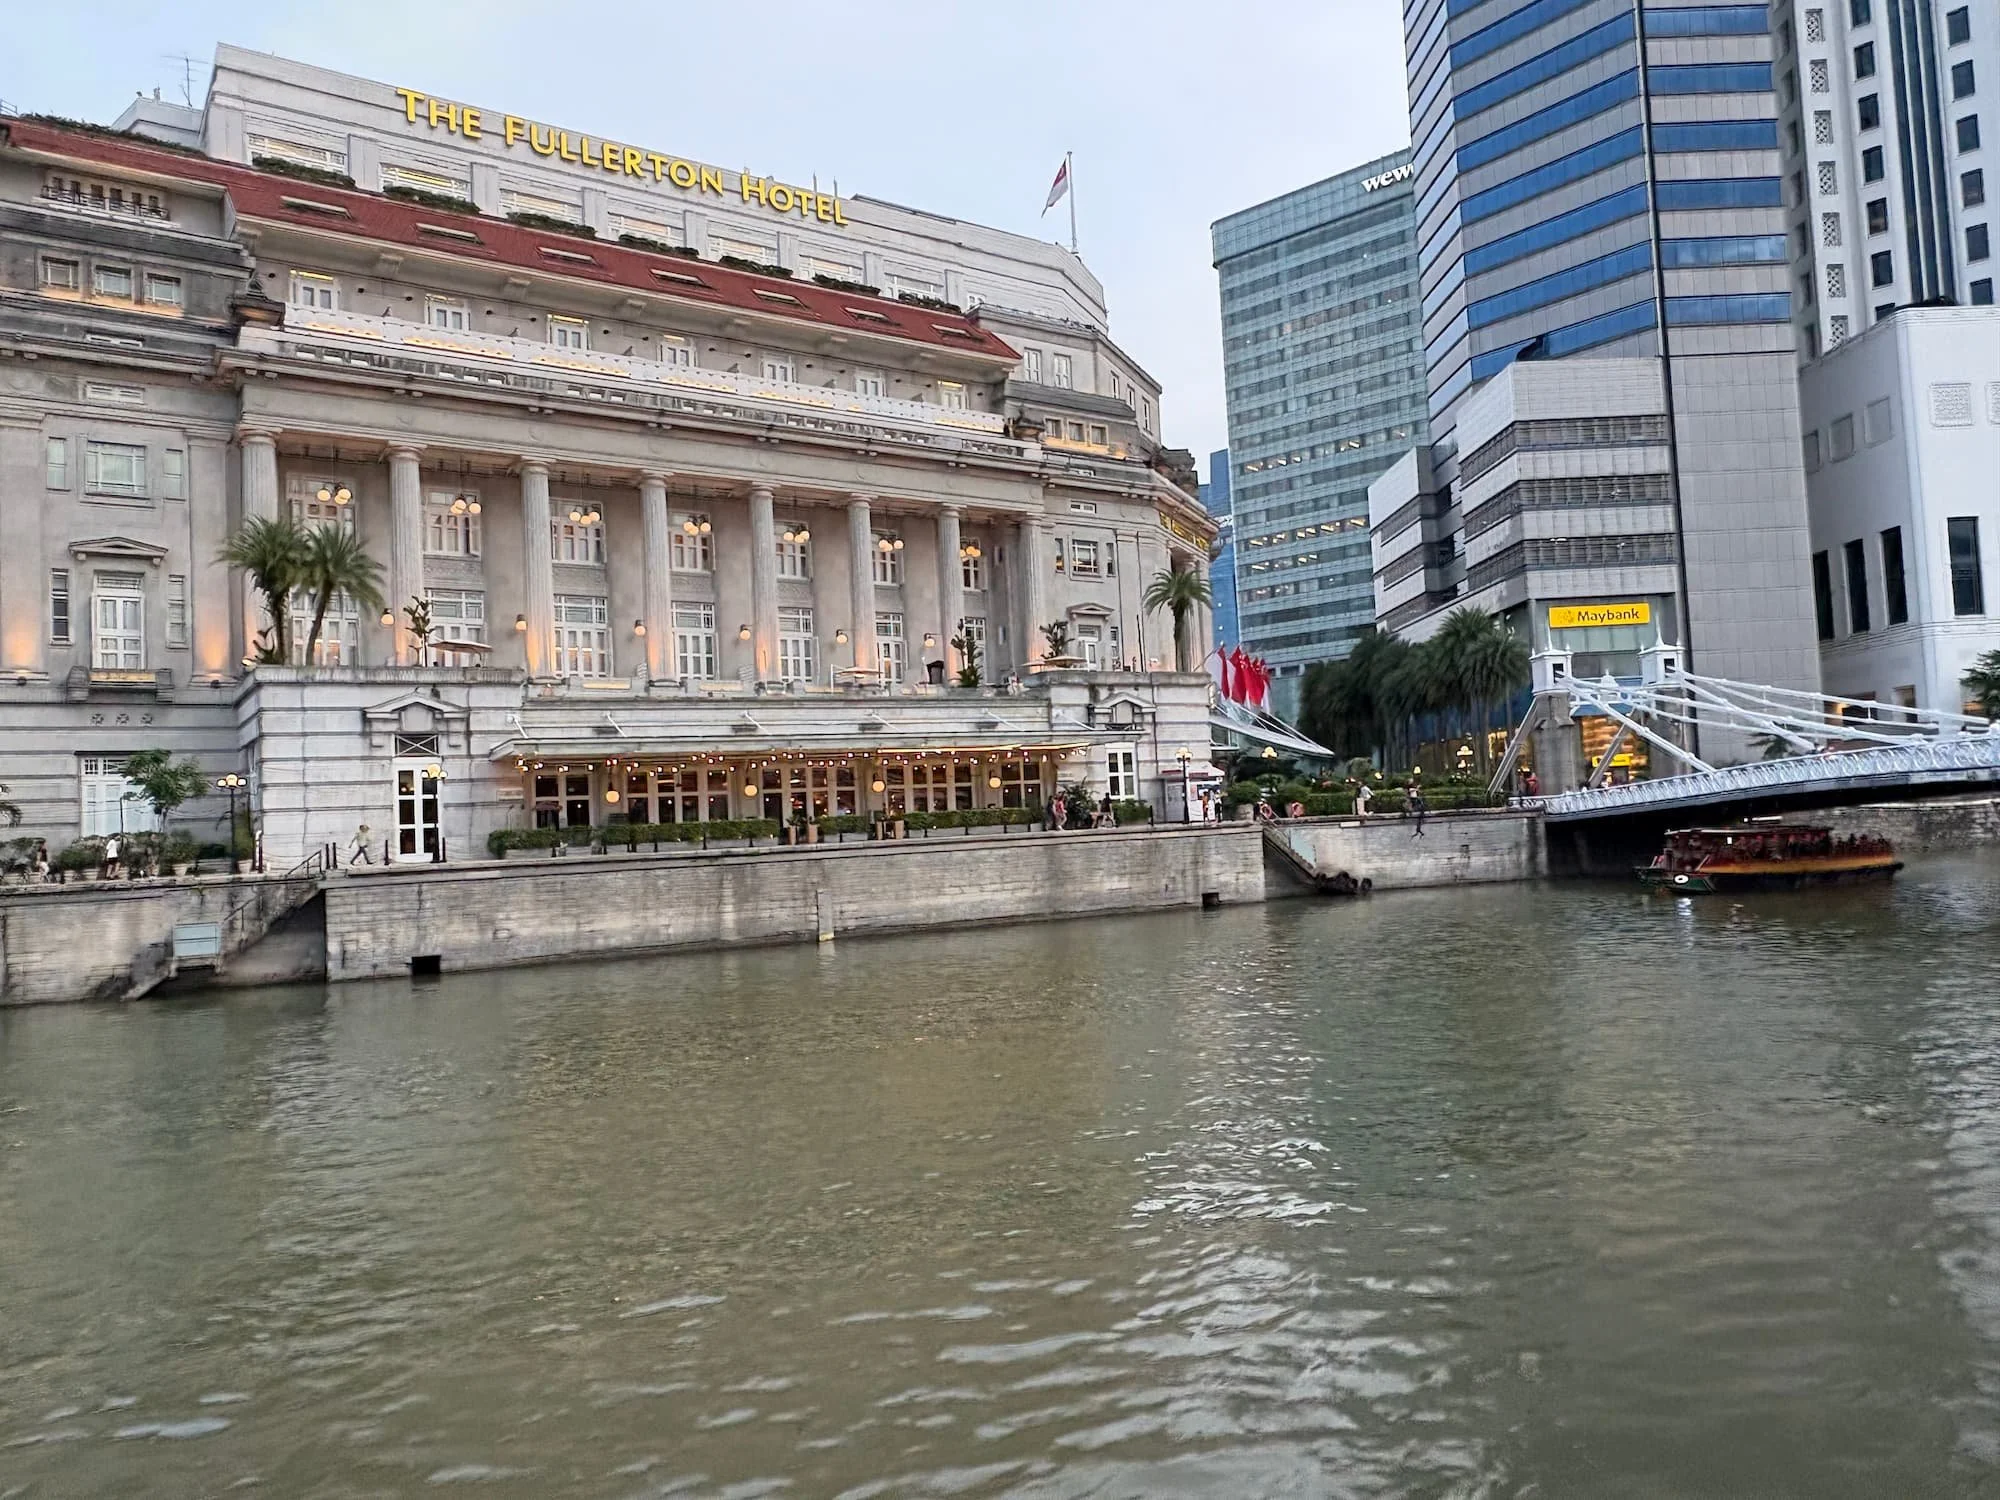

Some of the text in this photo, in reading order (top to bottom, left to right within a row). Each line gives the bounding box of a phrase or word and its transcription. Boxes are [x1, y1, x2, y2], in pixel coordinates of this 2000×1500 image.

[395, 87, 849, 226] THE FULLERTON HOTEL
[1360, 163, 1414, 193] wew
[1577, 608, 1640, 623] Maybank
